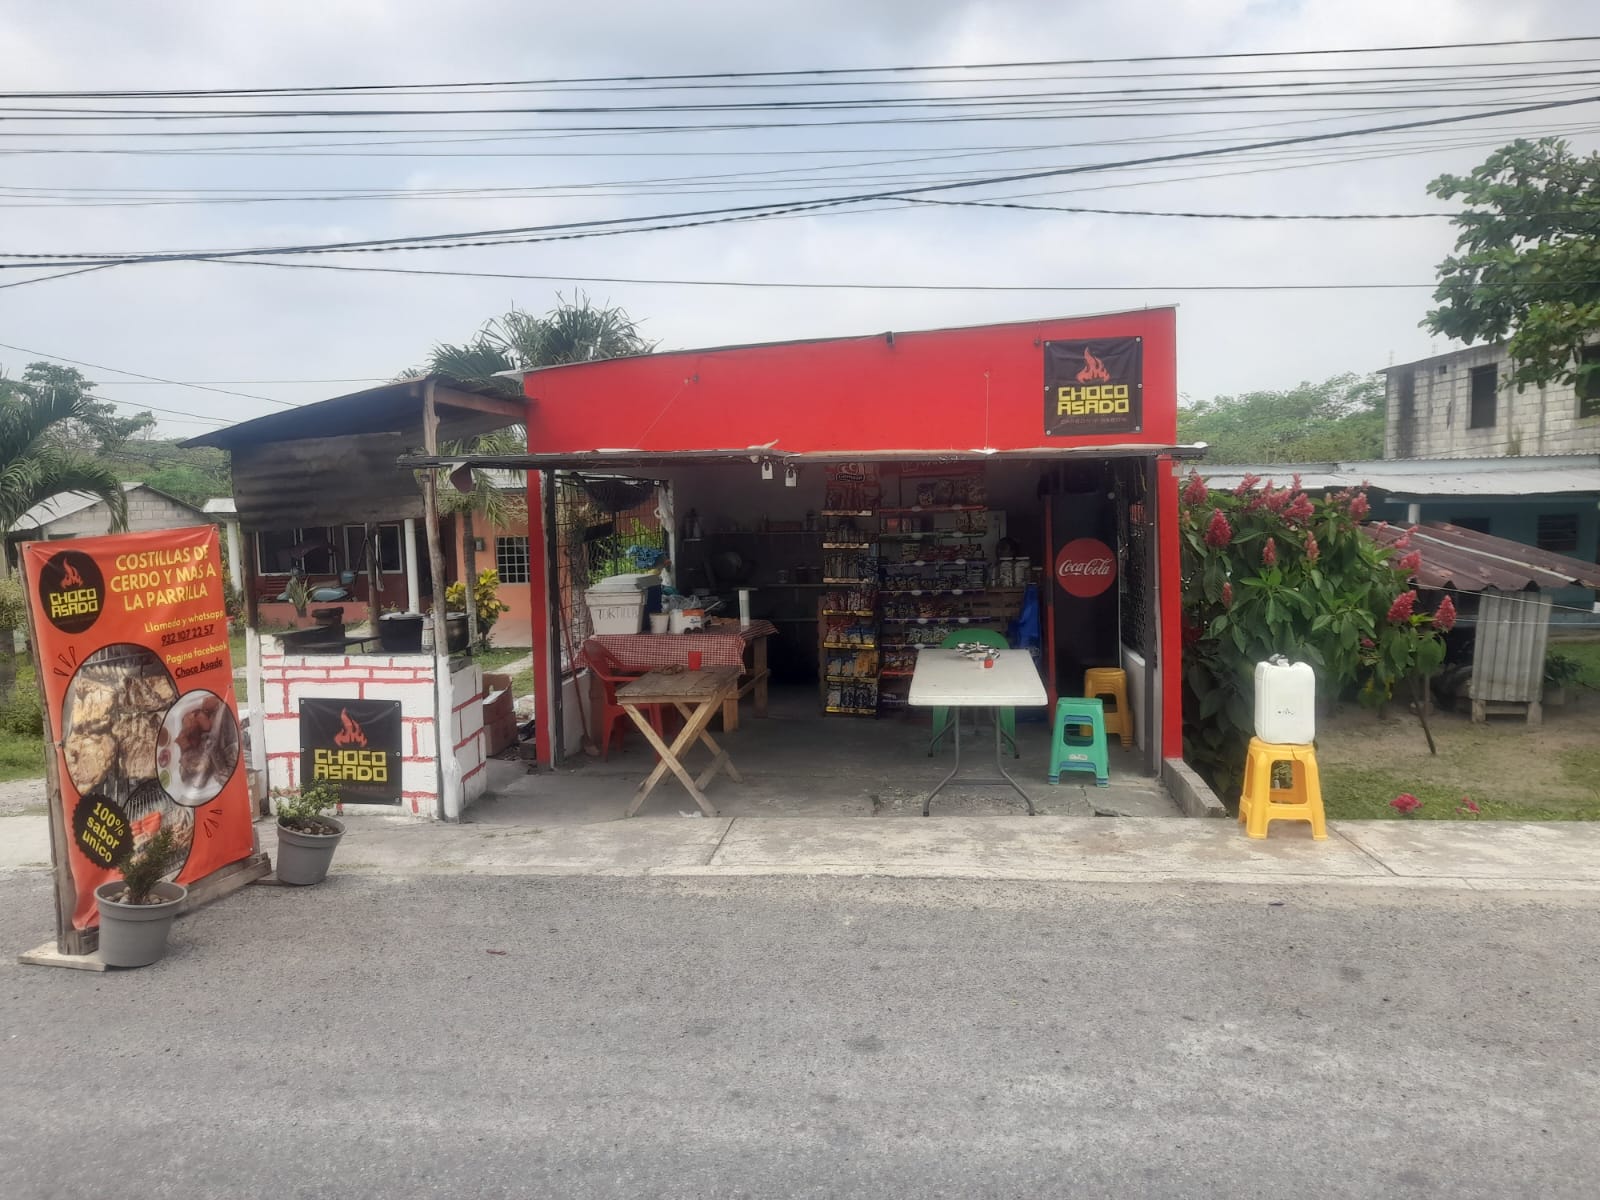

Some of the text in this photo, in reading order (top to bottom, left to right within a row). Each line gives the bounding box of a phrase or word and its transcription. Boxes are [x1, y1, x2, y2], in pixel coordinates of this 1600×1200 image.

[1058, 384, 1129, 401] CHOCO
[1057, 399, 1129, 416] ASADO
[115, 544, 209, 571] COSTILLAS DE
[1058, 558, 1113, 577] Coca-Cola
[110, 562, 217, 593] CERDO Y MAS A
[49, 587, 97, 606] CHOCO
[124, 582, 209, 611] LA PARRILLA
[51, 599, 98, 618] ASADO
[144, 610, 225, 633] Llamada y whatsapp
[204, 624, 214, 635] 57
[166, 640, 227, 665] Pagina facebook
[175, 657, 223, 678] Choco Asado
[313, 748, 387, 767] CHOCO
[313, 763, 388, 783] ASADO
[93, 802, 125, 836] 100%
[87, 816, 120, 849] sabor
[82, 830, 112, 863] unico
